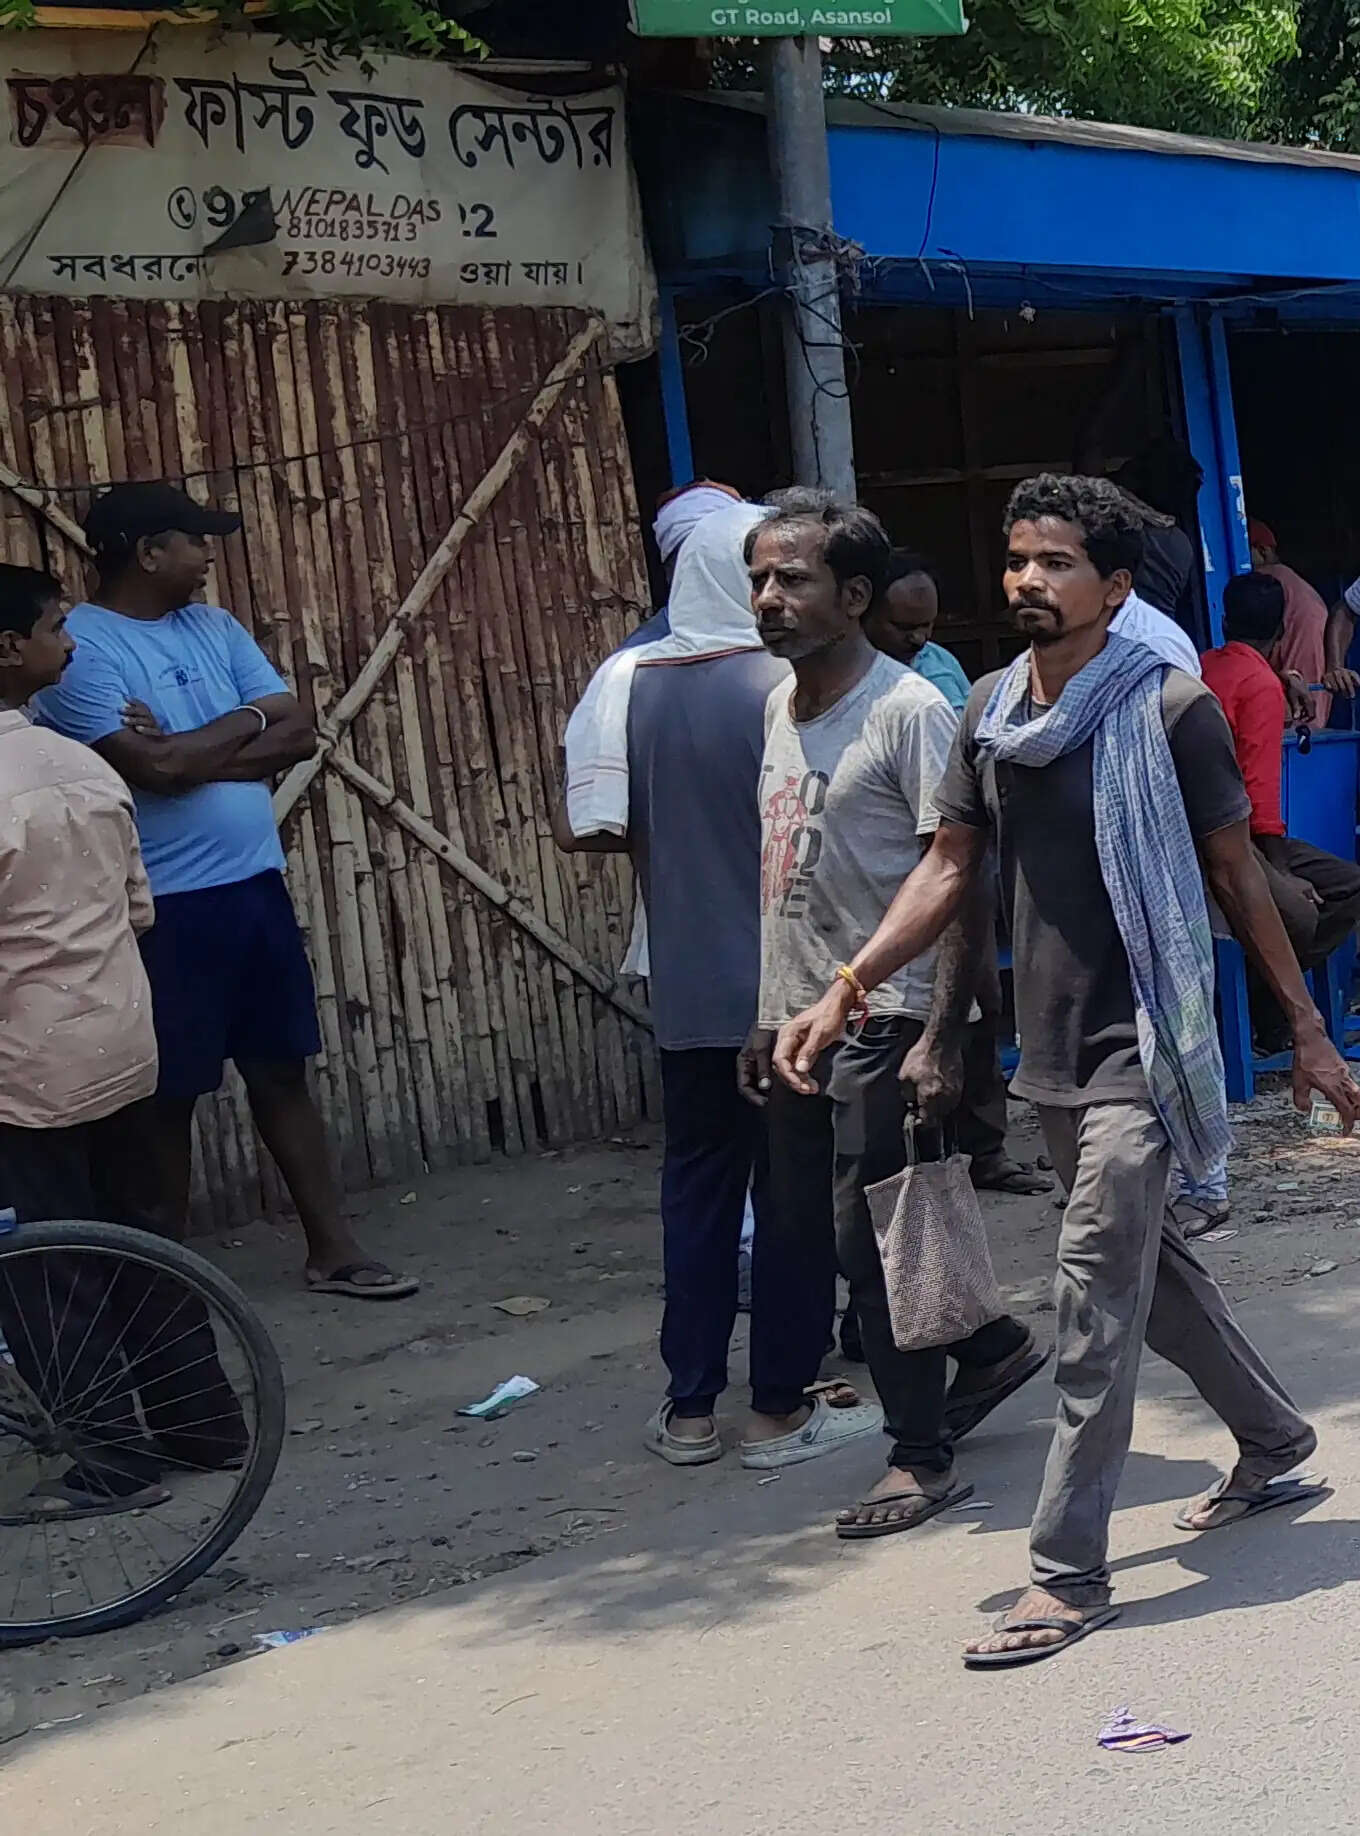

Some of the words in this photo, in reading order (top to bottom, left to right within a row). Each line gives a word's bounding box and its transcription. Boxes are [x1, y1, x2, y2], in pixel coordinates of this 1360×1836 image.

[711, 9, 740, 25] GT
[745, 8, 805, 28] Road,
[810, 8, 892, 25] Asansol
[172, 58, 317, 154] ফাস্ট
[326, 90, 426, 175] ফুড
[448, 95, 616, 170] সেন্টার
[273, 186, 385, 218] NEPAL
[390, 194, 442, 225] DAS
[287, 215, 418, 242] 8101835713
[280, 250, 432, 279] 7384103443
